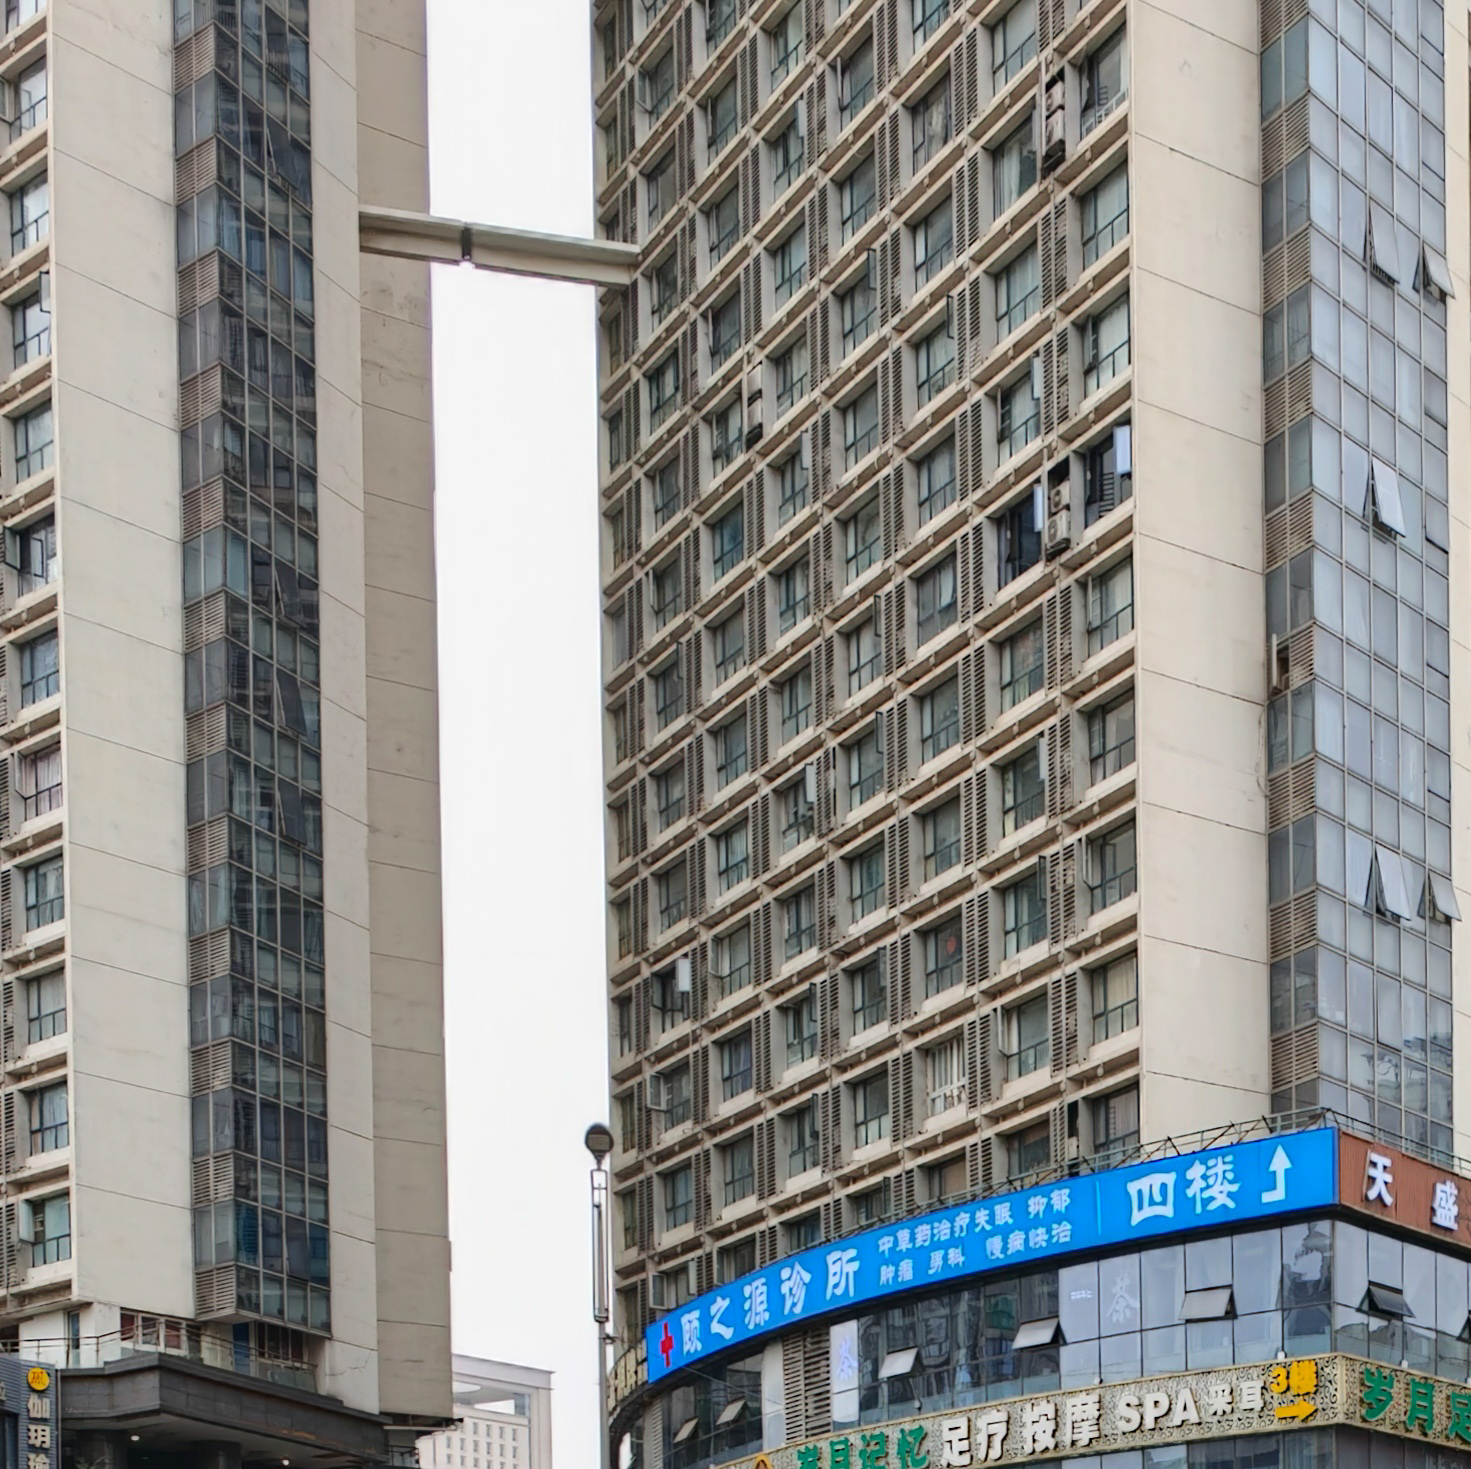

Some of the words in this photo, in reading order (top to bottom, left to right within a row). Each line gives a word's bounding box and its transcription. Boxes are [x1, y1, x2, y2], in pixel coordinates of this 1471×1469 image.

[877, 1201, 1015, 1260] 中草药治疗失眠
[1027, 1187, 1072, 1220] 抑郁
[1125, 1154, 1242, 1228] 四楼
[879, 1258, 915, 1287] 肿瘤
[927, 1245, 966, 1276] 男科
[985, 1219, 1073, 1260] 慢病快治
[939, 1393, 1102, 1468] 足疗按摩
[1116, 1387, 1202, 1433] SPA
[1204, 1378, 1266, 1418] 采耳
